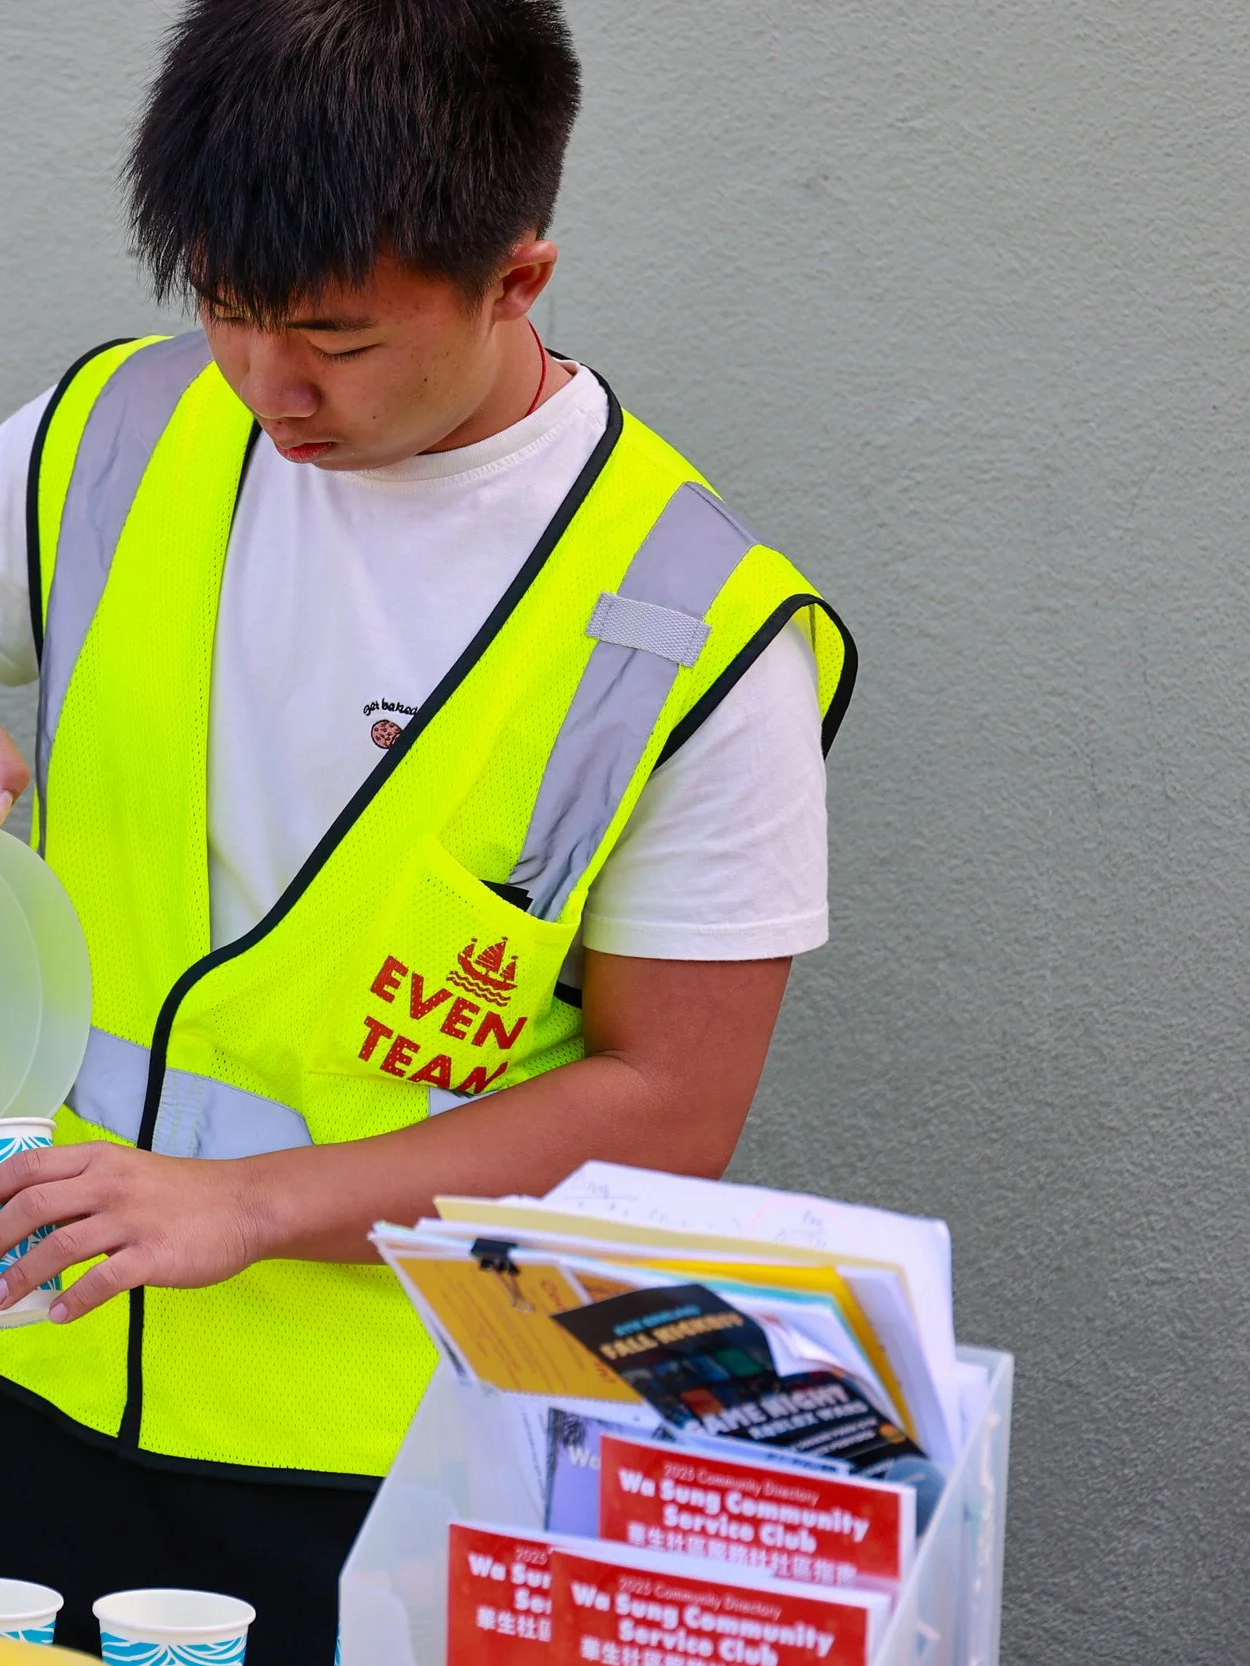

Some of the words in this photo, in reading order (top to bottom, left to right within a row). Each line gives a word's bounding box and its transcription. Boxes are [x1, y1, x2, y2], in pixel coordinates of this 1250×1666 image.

[363, 700, 380, 716] get
[759, 1383, 851, 1418] NIGHT
[617, 1467, 656, 1497] Wa
[659, 1477, 722, 1514] Sung
[724, 1490, 870, 1543] Community
[663, 1461, 695, 1482] 2025
[698, 1468, 763, 1496] Community
[763, 1479, 820, 1506] Directory
[662, 1503, 755, 1543] Service
[758, 1522, 817, 1554] Club
[467, 1552, 507, 1582] Wa
[515, 1548, 549, 1566] 2025
[570, 1580, 611, 1612] Wa
[615, 1591, 679, 1630] Sung
[682, 1604, 835, 1658] Community
[617, 1574, 651, 1596] 2025
[654, 1580, 722, 1611] Community
[723, 1593, 783, 1621] Directory
[617, 1617, 714, 1658] Service
[718, 1635, 779, 1666] Club
